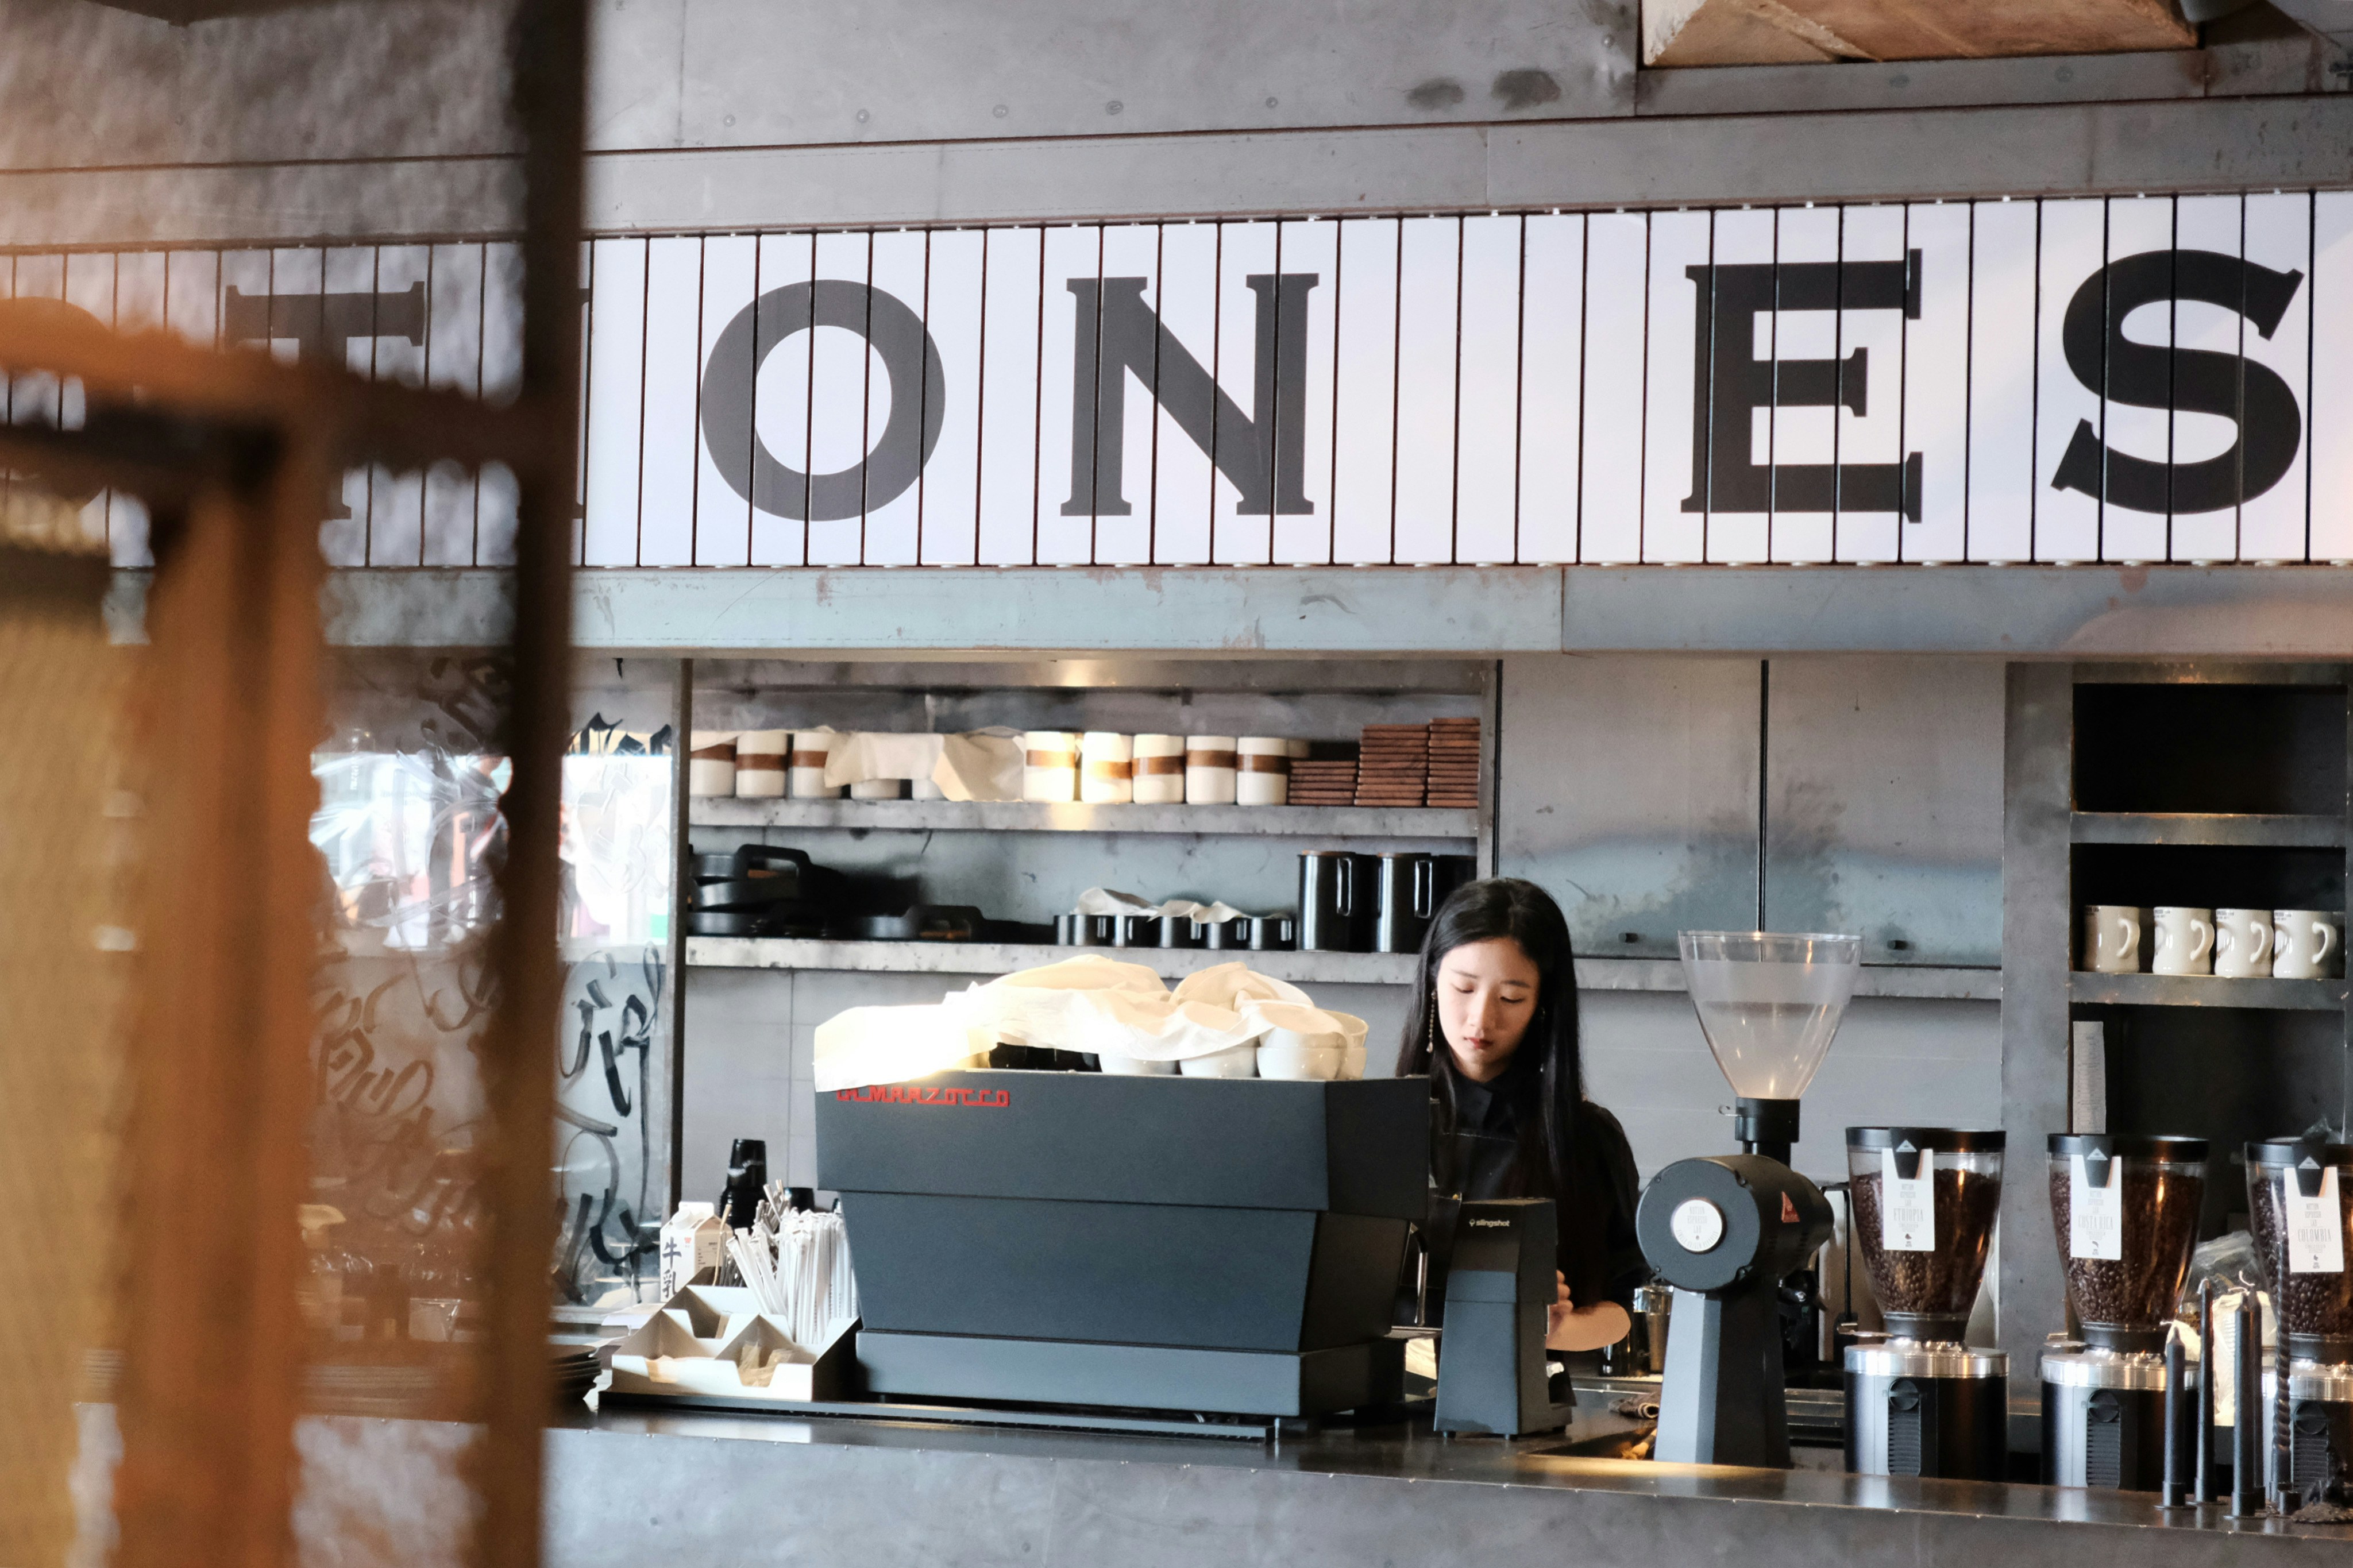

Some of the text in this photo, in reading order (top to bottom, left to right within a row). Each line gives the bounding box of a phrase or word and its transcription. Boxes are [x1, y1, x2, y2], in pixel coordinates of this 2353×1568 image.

[1681, 249, 2305, 524] ES
[869, 1084, 1009, 1107] MARZOCCO
[1476, 1219, 1510, 1227] slingshot
[1893, 1208, 1924, 1222] ETHIOPIA
[2298, 1228, 2331, 1242] COLOMBIA
[662, 1236, 682, 1299] 牛乳
